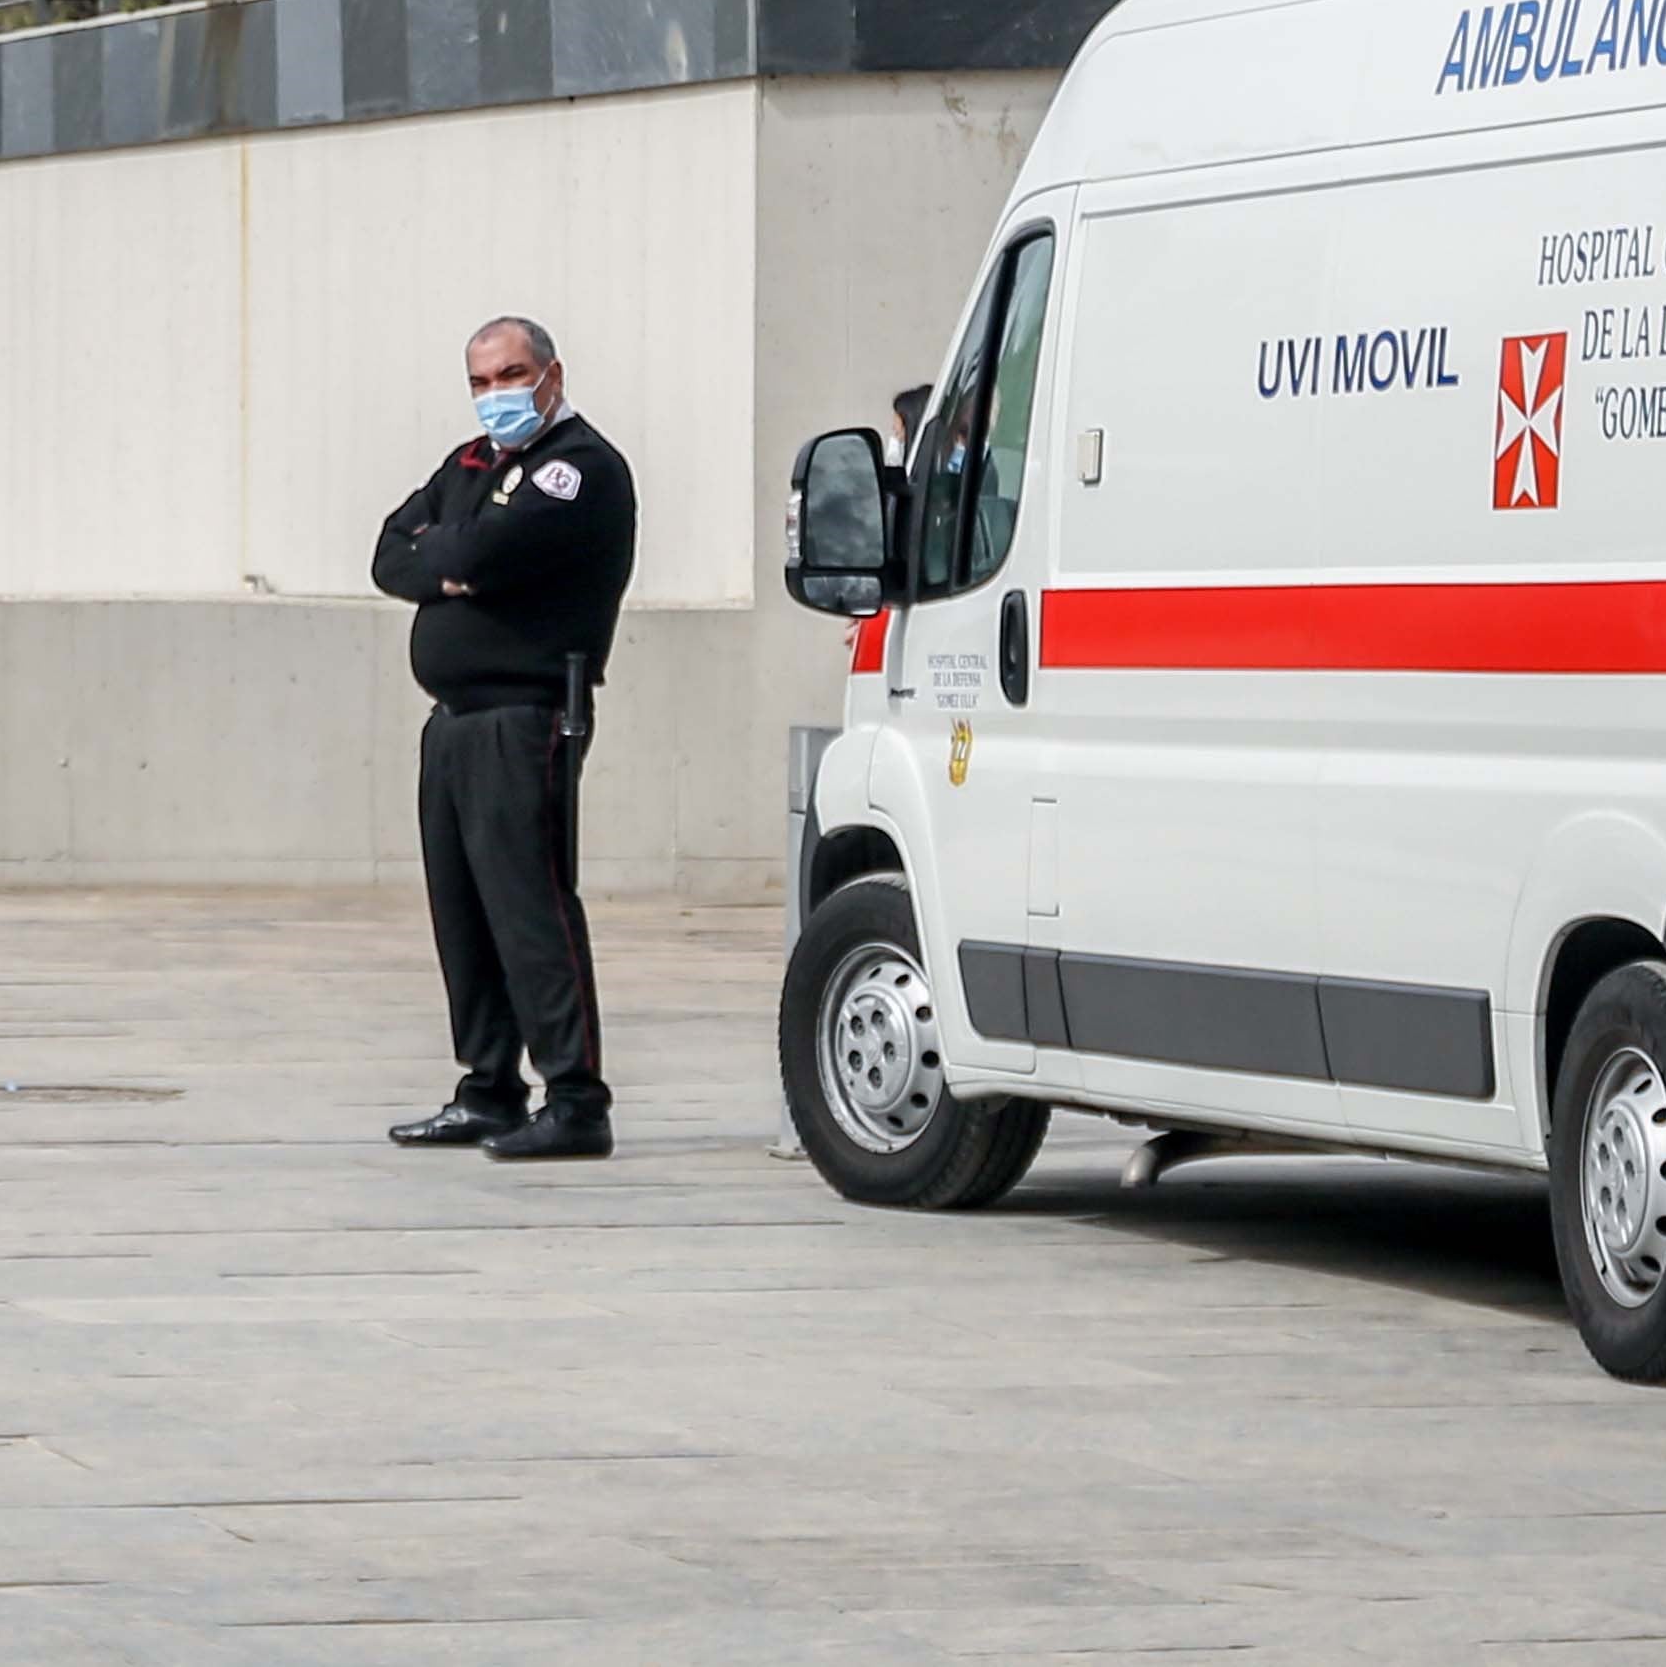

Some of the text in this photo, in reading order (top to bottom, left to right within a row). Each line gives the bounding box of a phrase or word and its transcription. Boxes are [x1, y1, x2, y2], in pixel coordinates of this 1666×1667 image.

[1537, 225, 1656, 286] HOSPITAL
[1258, 327, 1460, 399] UVI MOVIL
[1581, 308, 1616, 361] DE
[1619, 305, 1651, 359] LA
